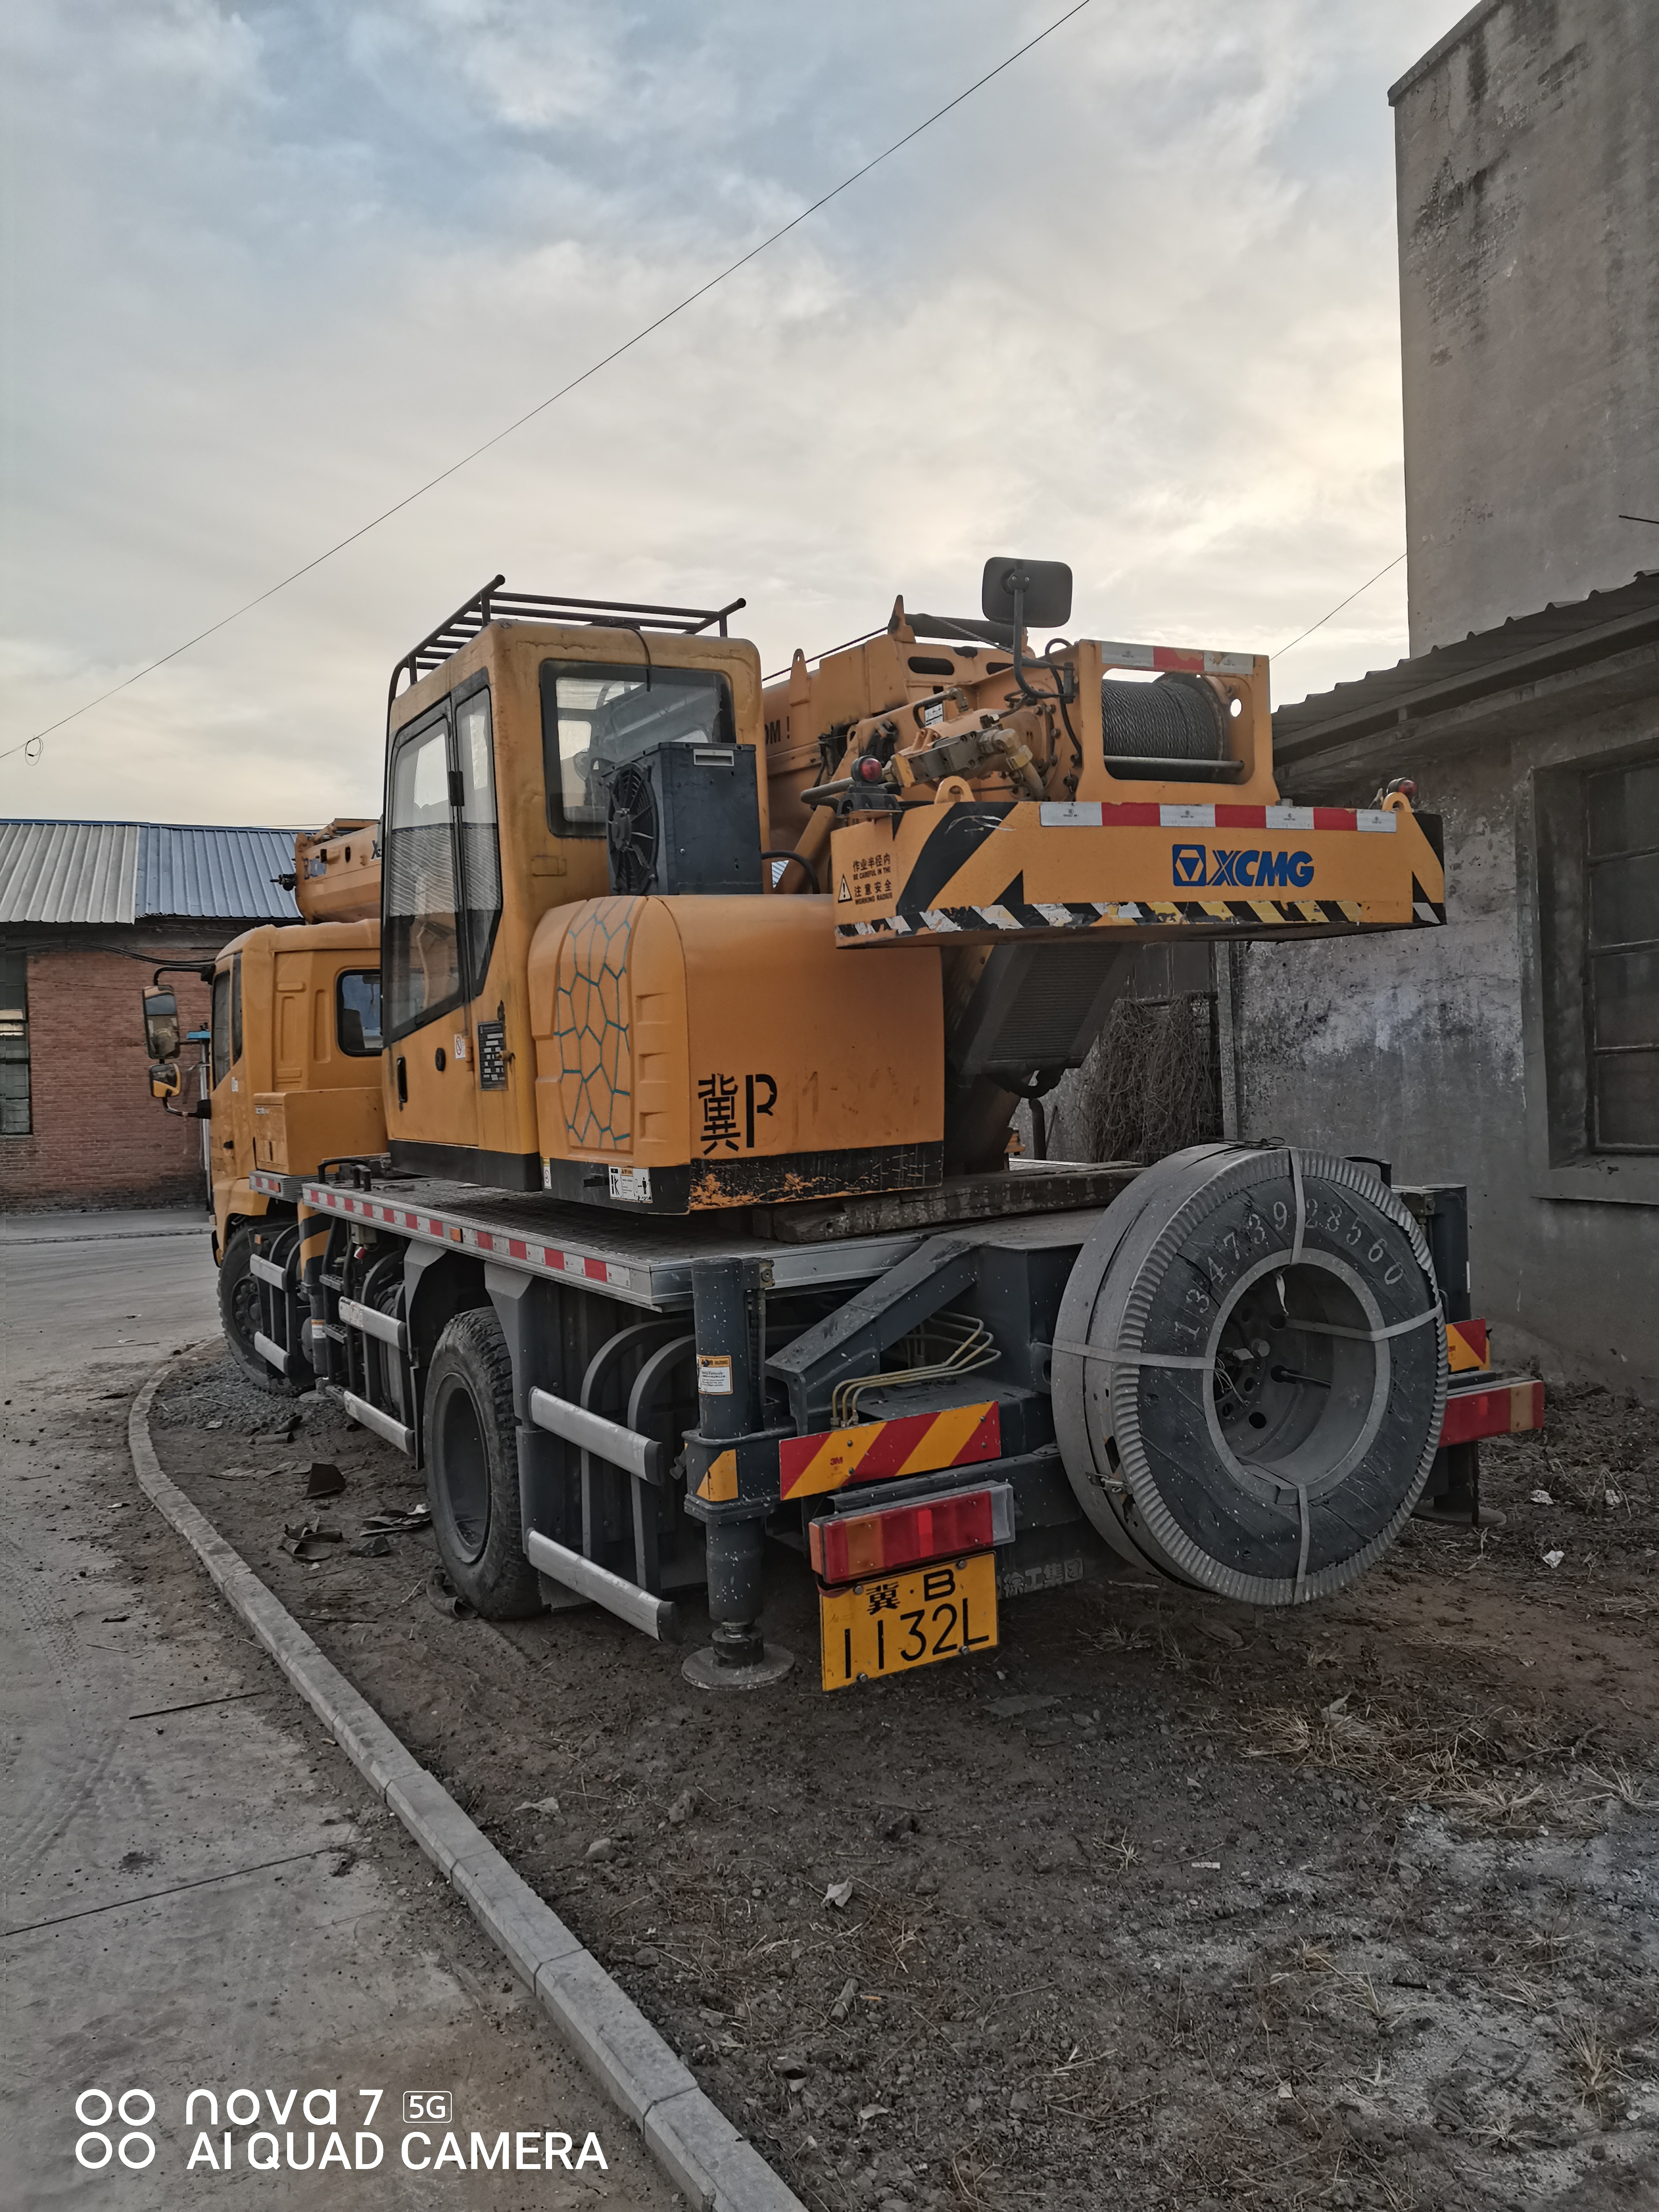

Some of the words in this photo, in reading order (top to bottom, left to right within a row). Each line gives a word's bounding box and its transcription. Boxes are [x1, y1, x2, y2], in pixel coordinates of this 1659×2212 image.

[853, 853, 890, 872] 作业半径内
[1206, 850, 1314, 888] XCMG
[854, 879, 892, 897] 注意安全
[845, 1598, 989, 1679] 1132L
